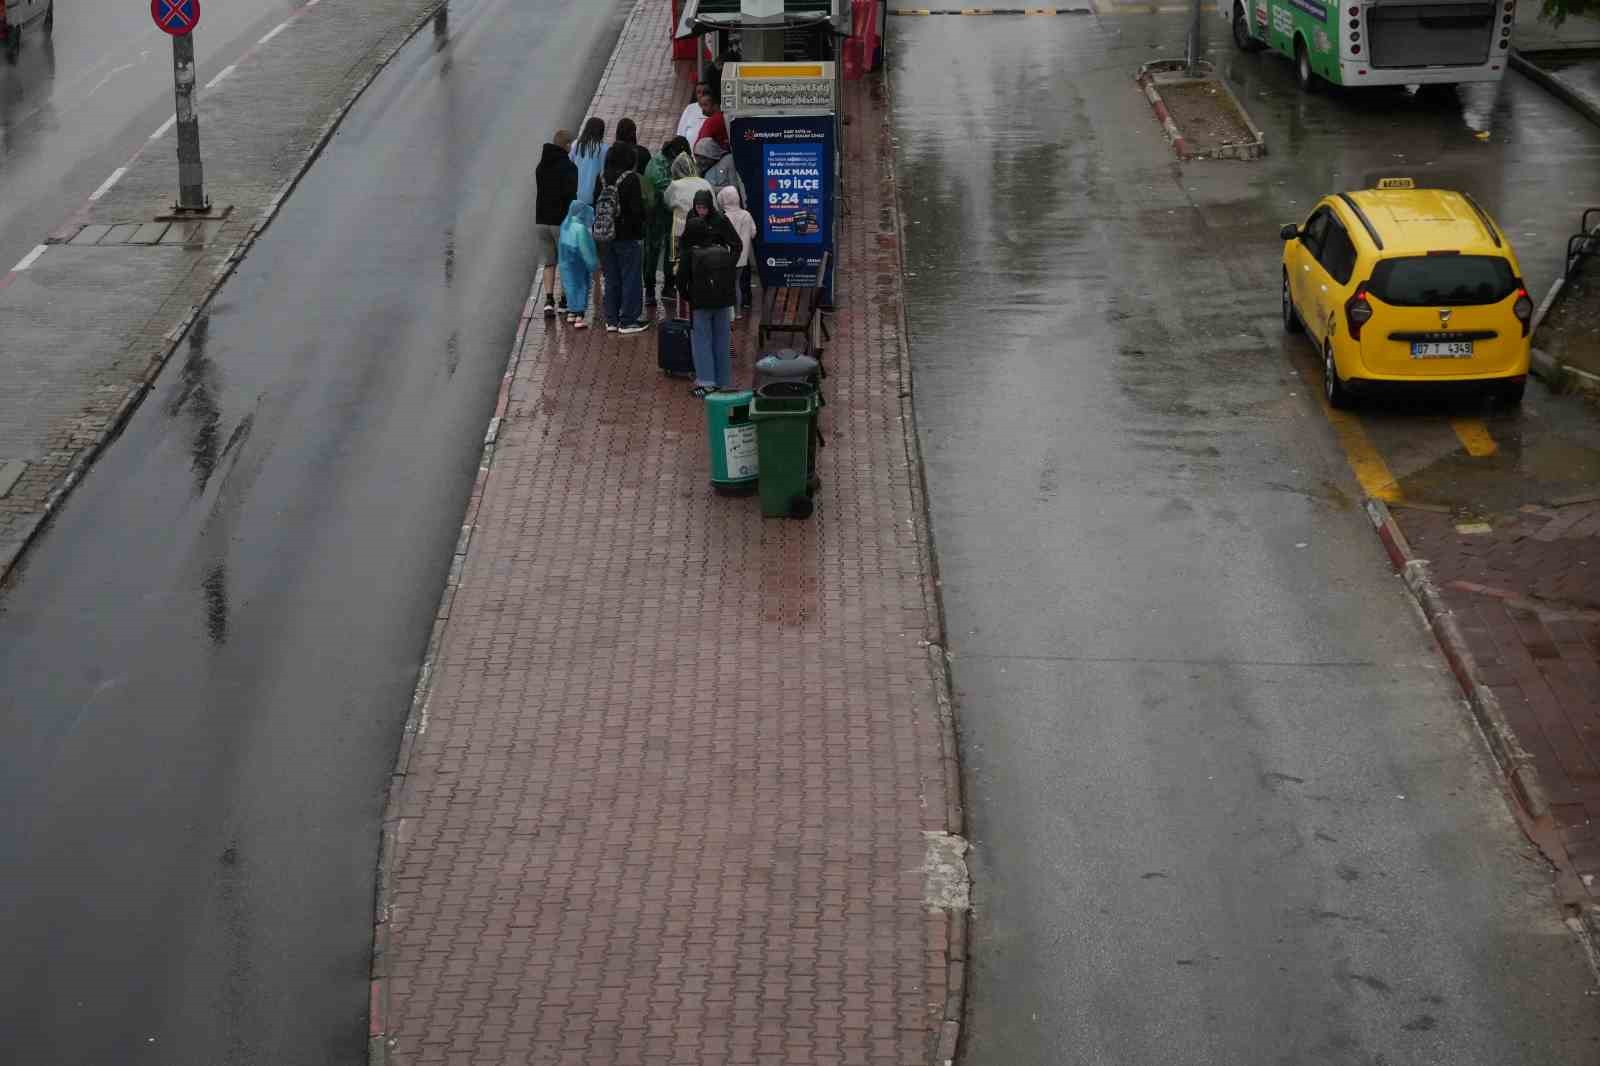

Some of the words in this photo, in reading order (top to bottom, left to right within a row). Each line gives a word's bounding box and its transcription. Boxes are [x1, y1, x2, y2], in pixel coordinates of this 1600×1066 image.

[767, 168, 791, 176] HALK
[792, 168, 819, 176] MAMA
[778, 179, 792, 189] 19
[793, 176, 820, 191] İLÇE
[769, 192, 799, 204] 6-24
